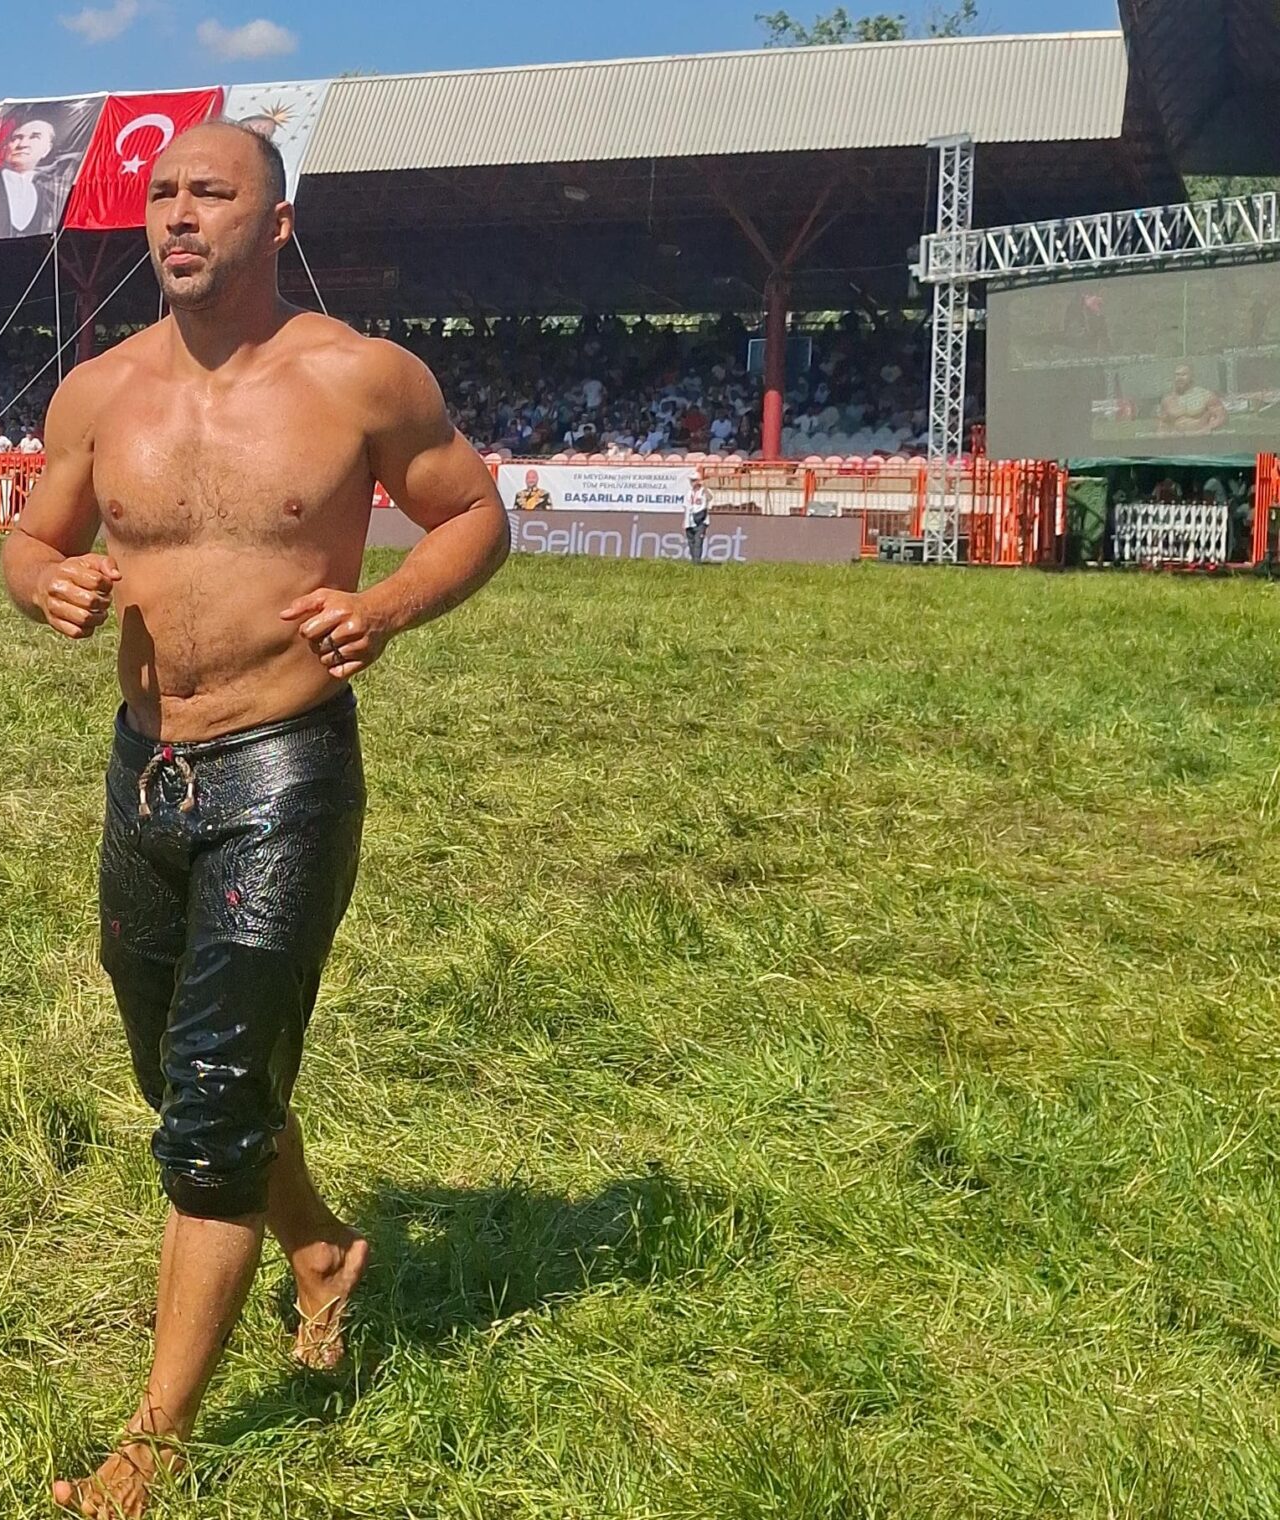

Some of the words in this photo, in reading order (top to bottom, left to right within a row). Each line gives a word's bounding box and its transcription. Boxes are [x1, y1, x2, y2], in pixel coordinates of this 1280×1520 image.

[564, 492, 634, 504] BAŞARILAR
[636, 494, 685, 505] DİLERİM
[521, 519, 622, 557] Selim
